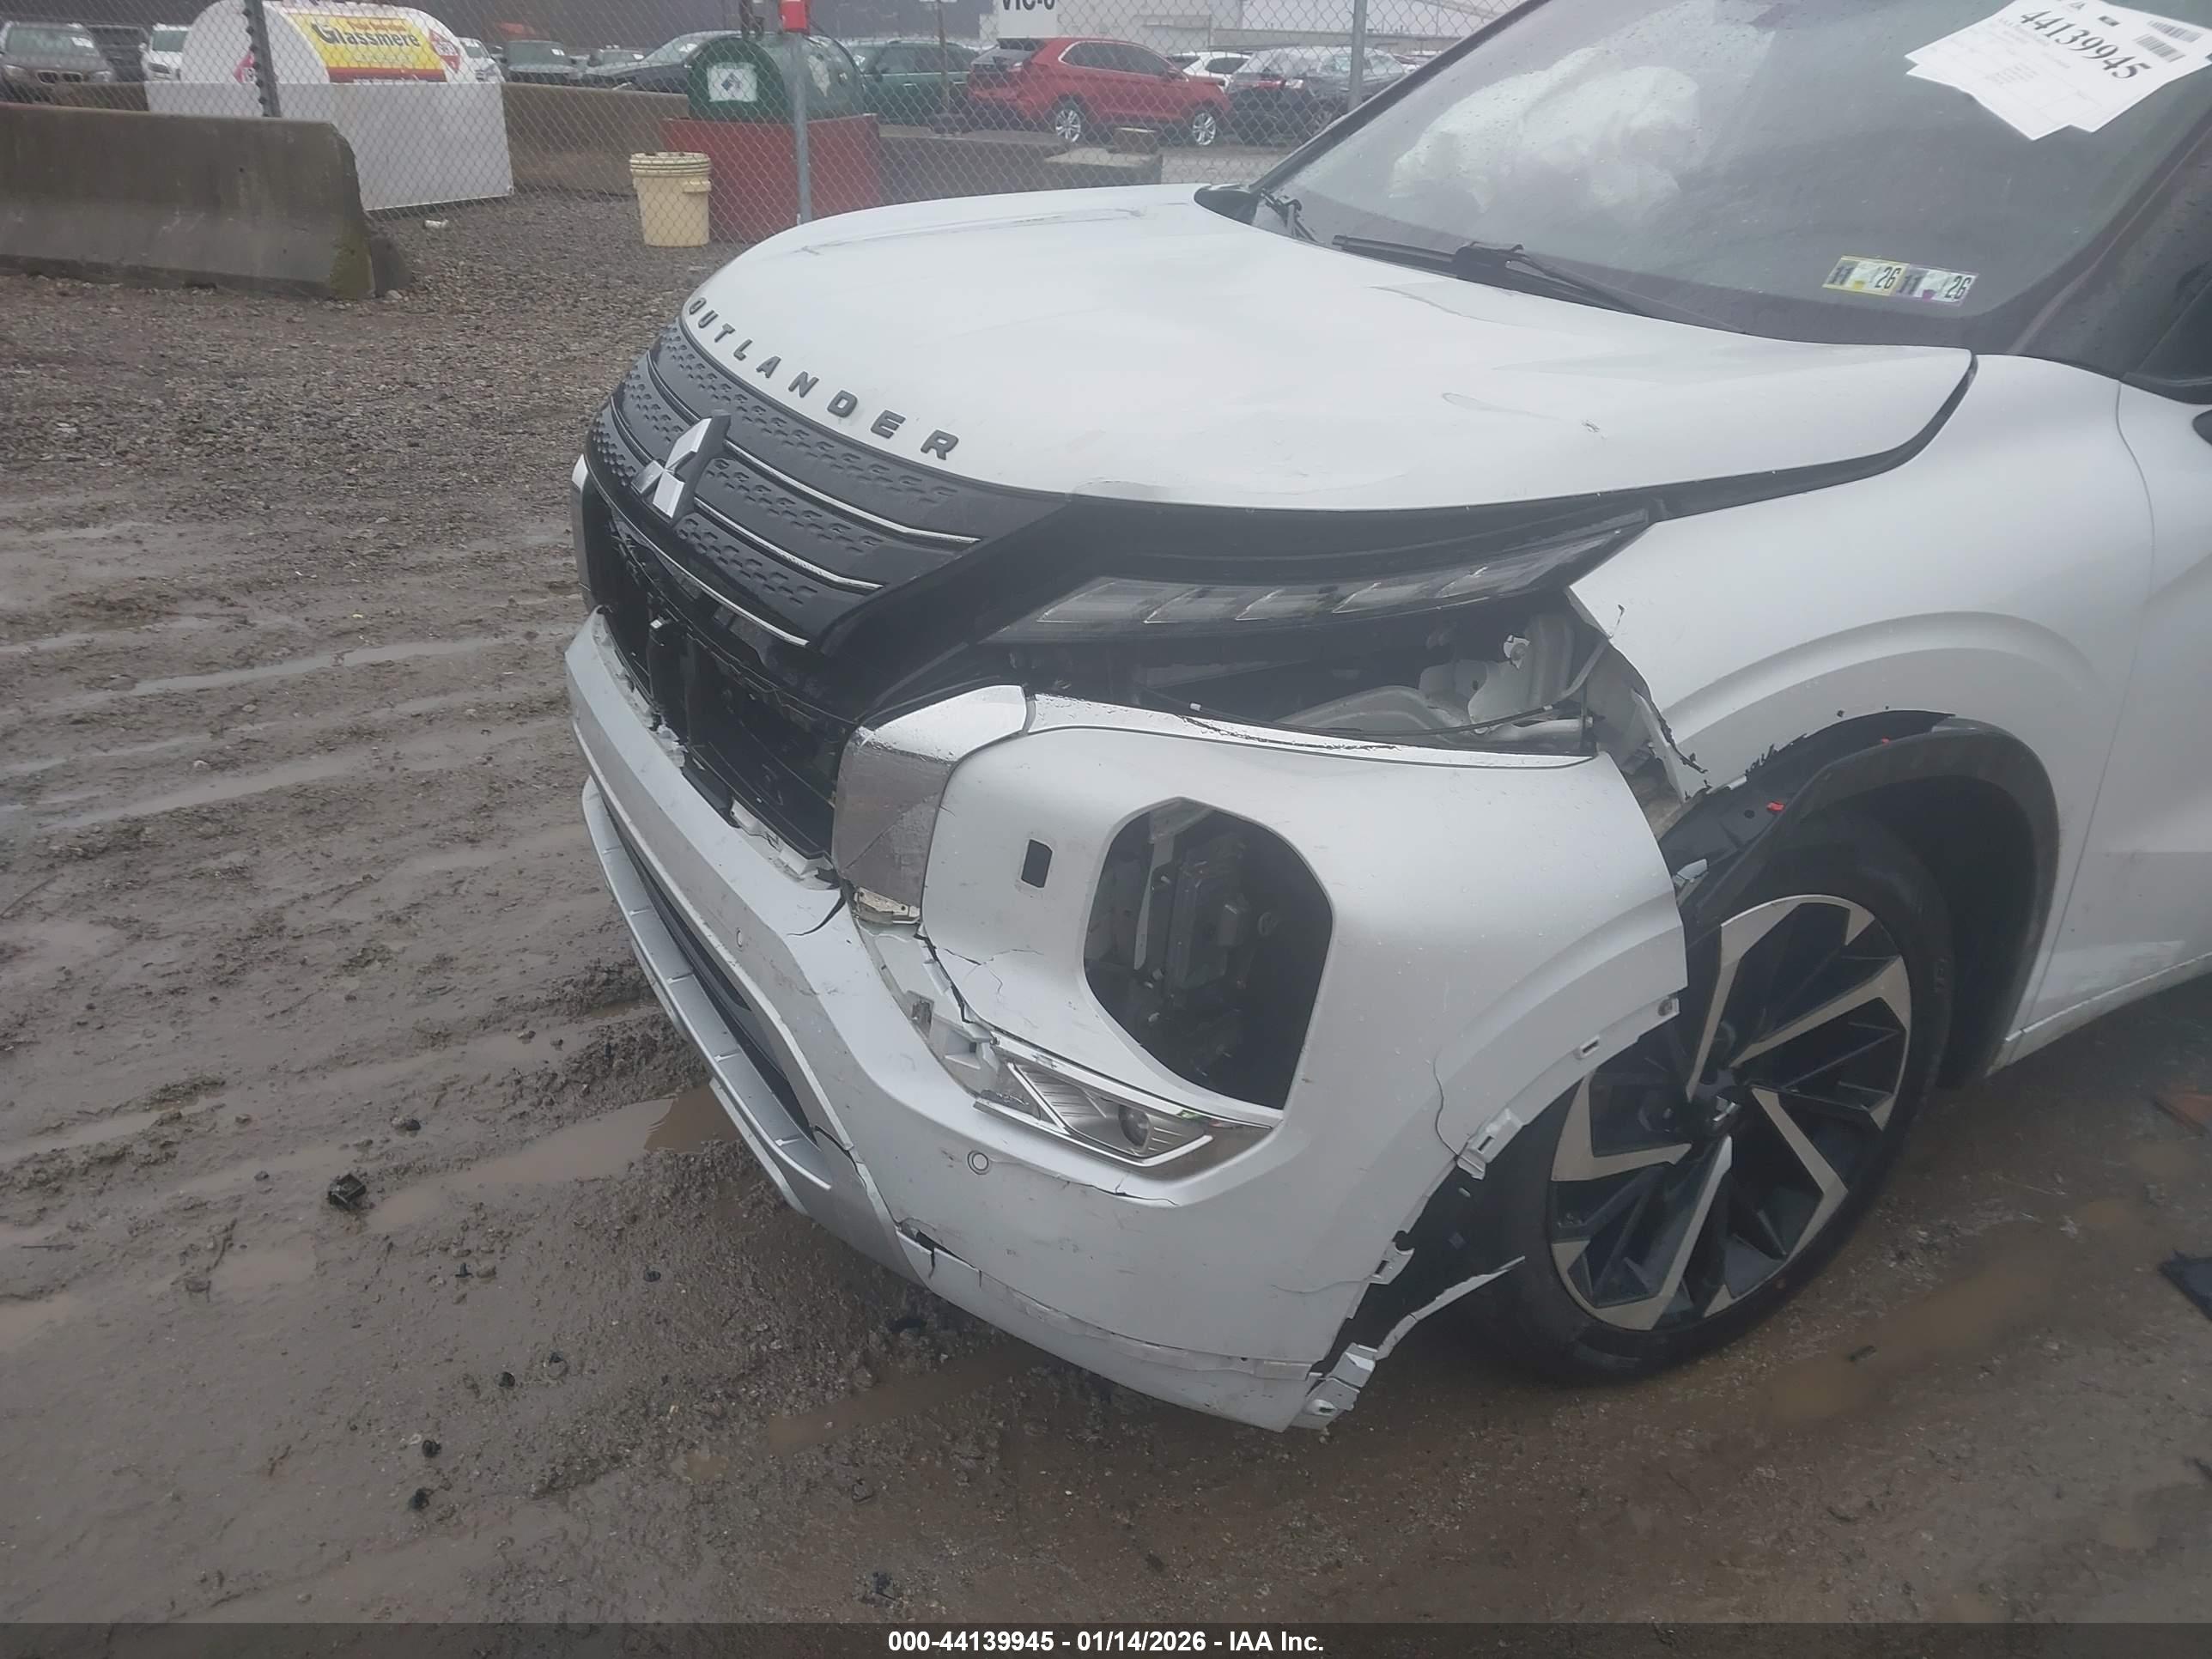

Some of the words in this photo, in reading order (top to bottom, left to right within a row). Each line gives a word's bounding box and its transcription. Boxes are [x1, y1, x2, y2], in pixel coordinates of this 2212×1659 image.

[311, 22, 421, 47] Glassmere
[2021, 9, 2152, 79] 44139945
[1875, 266, 1902, 289] 26
[1944, 276, 1972, 300] 26
[689, 296, 959, 460] OUTLANDER
